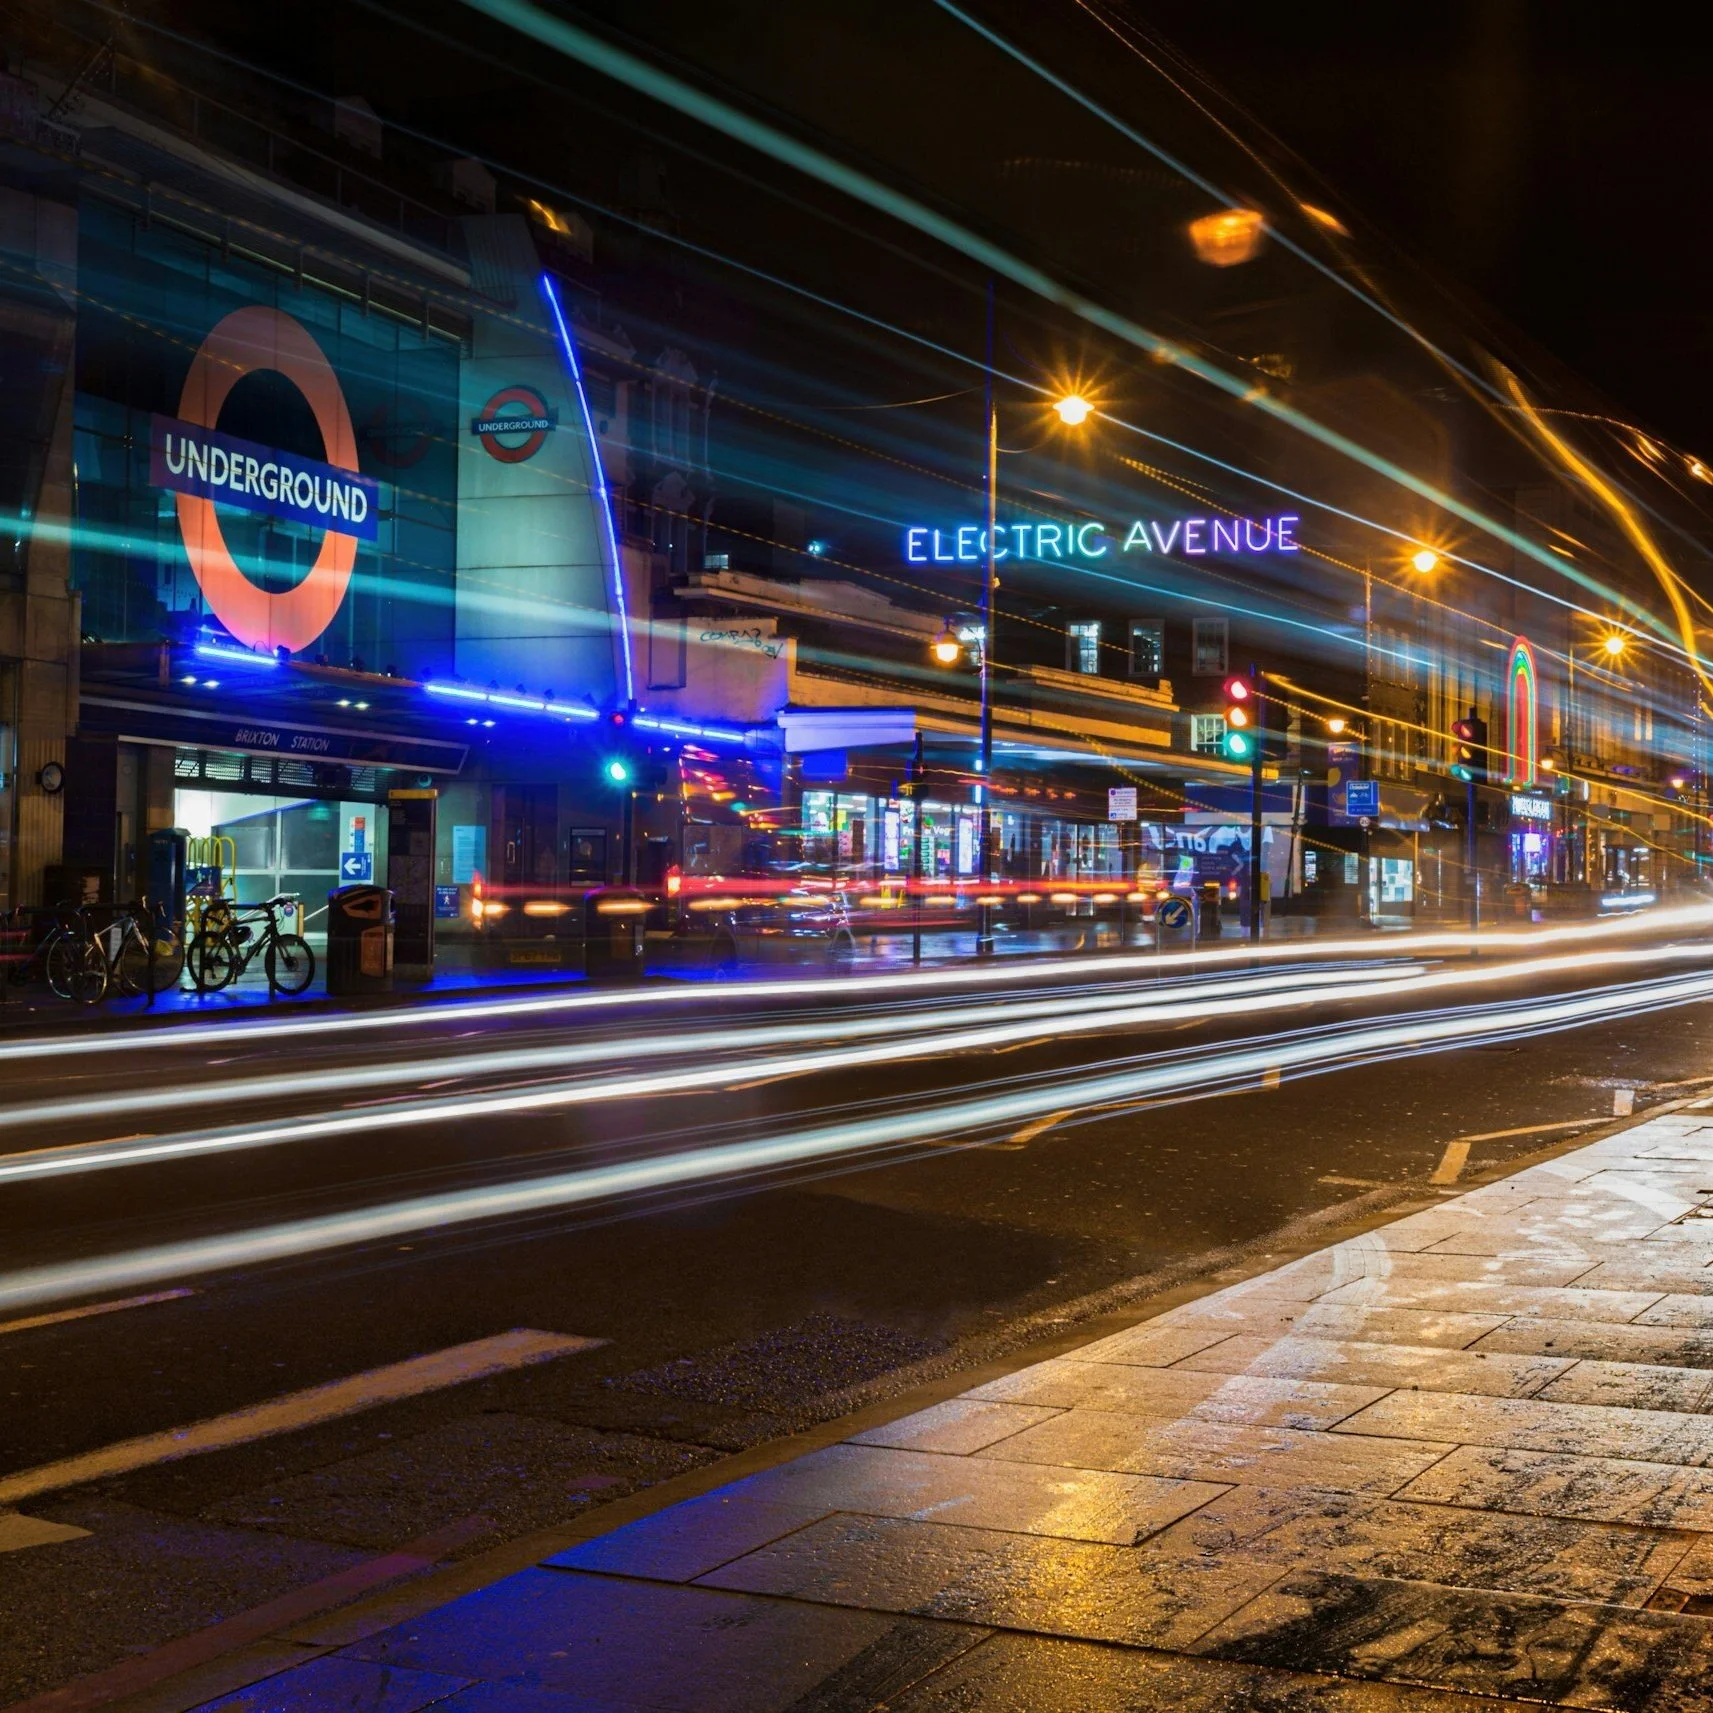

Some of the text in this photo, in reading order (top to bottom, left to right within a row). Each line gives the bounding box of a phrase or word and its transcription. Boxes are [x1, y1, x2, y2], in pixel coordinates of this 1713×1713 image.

[478, 420, 549, 432] UNDERGROUND
[165, 433, 368, 524] UNDERGROUND
[907, 516, 1300, 563] ELECTRIC AVENUE
[234, 729, 330, 752] BRIXTON STATION
